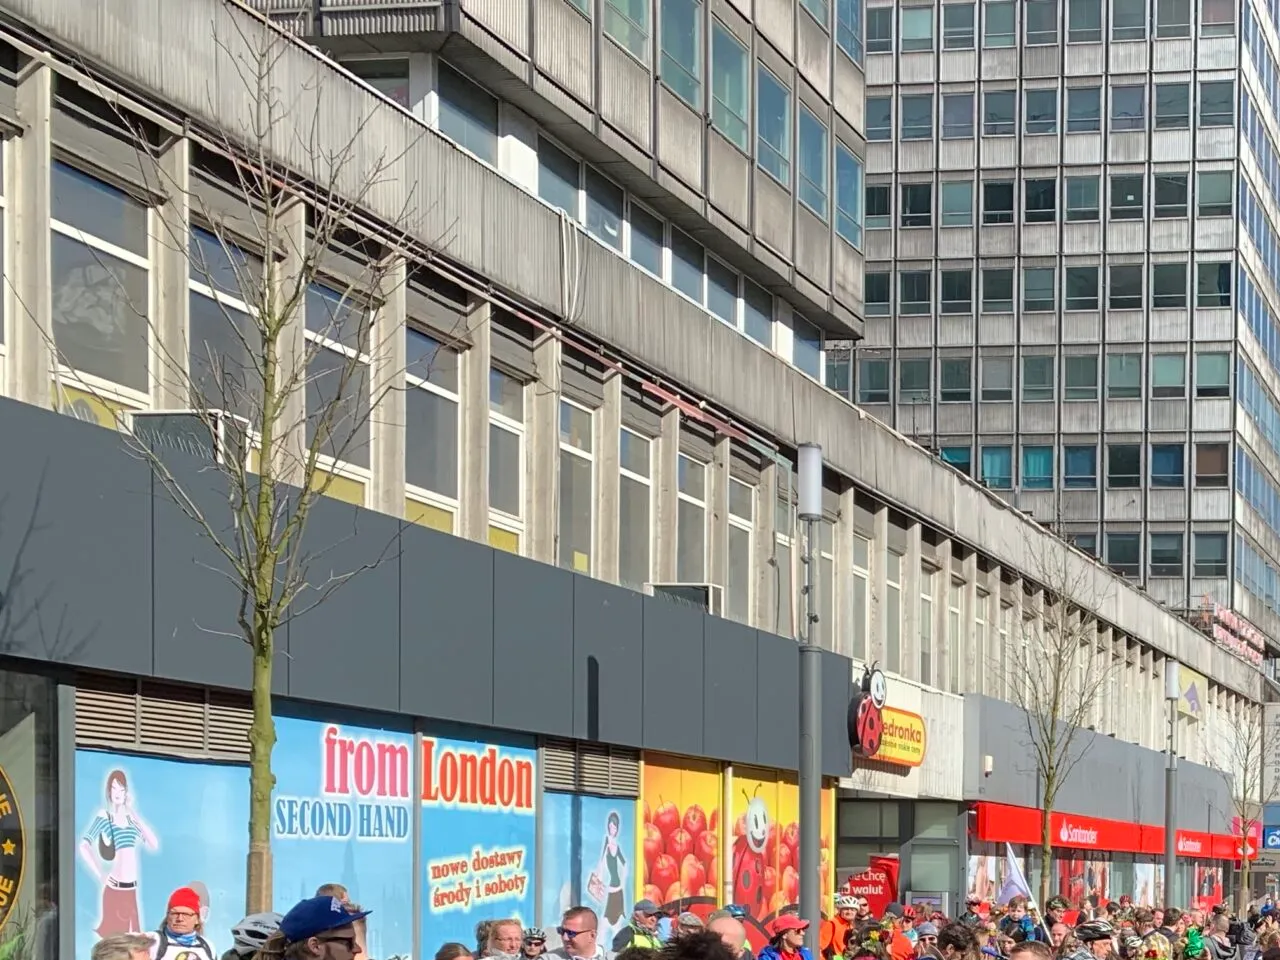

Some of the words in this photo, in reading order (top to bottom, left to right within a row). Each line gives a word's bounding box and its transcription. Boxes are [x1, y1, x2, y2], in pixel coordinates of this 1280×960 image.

[883, 719, 921, 743] edronka
[325, 727, 409, 797] from
[422, 741, 532, 808] London
[276, 799, 351, 836] SECOND
[358, 804, 408, 838] HAND
[1068, 824, 1098, 844] Santander
[431, 861, 468, 879] nowe
[473, 850, 523, 872] dostawy
[433, 882, 471, 906] środy
[476, 879, 481, 898] i
[484, 874, 526, 894] soboty
